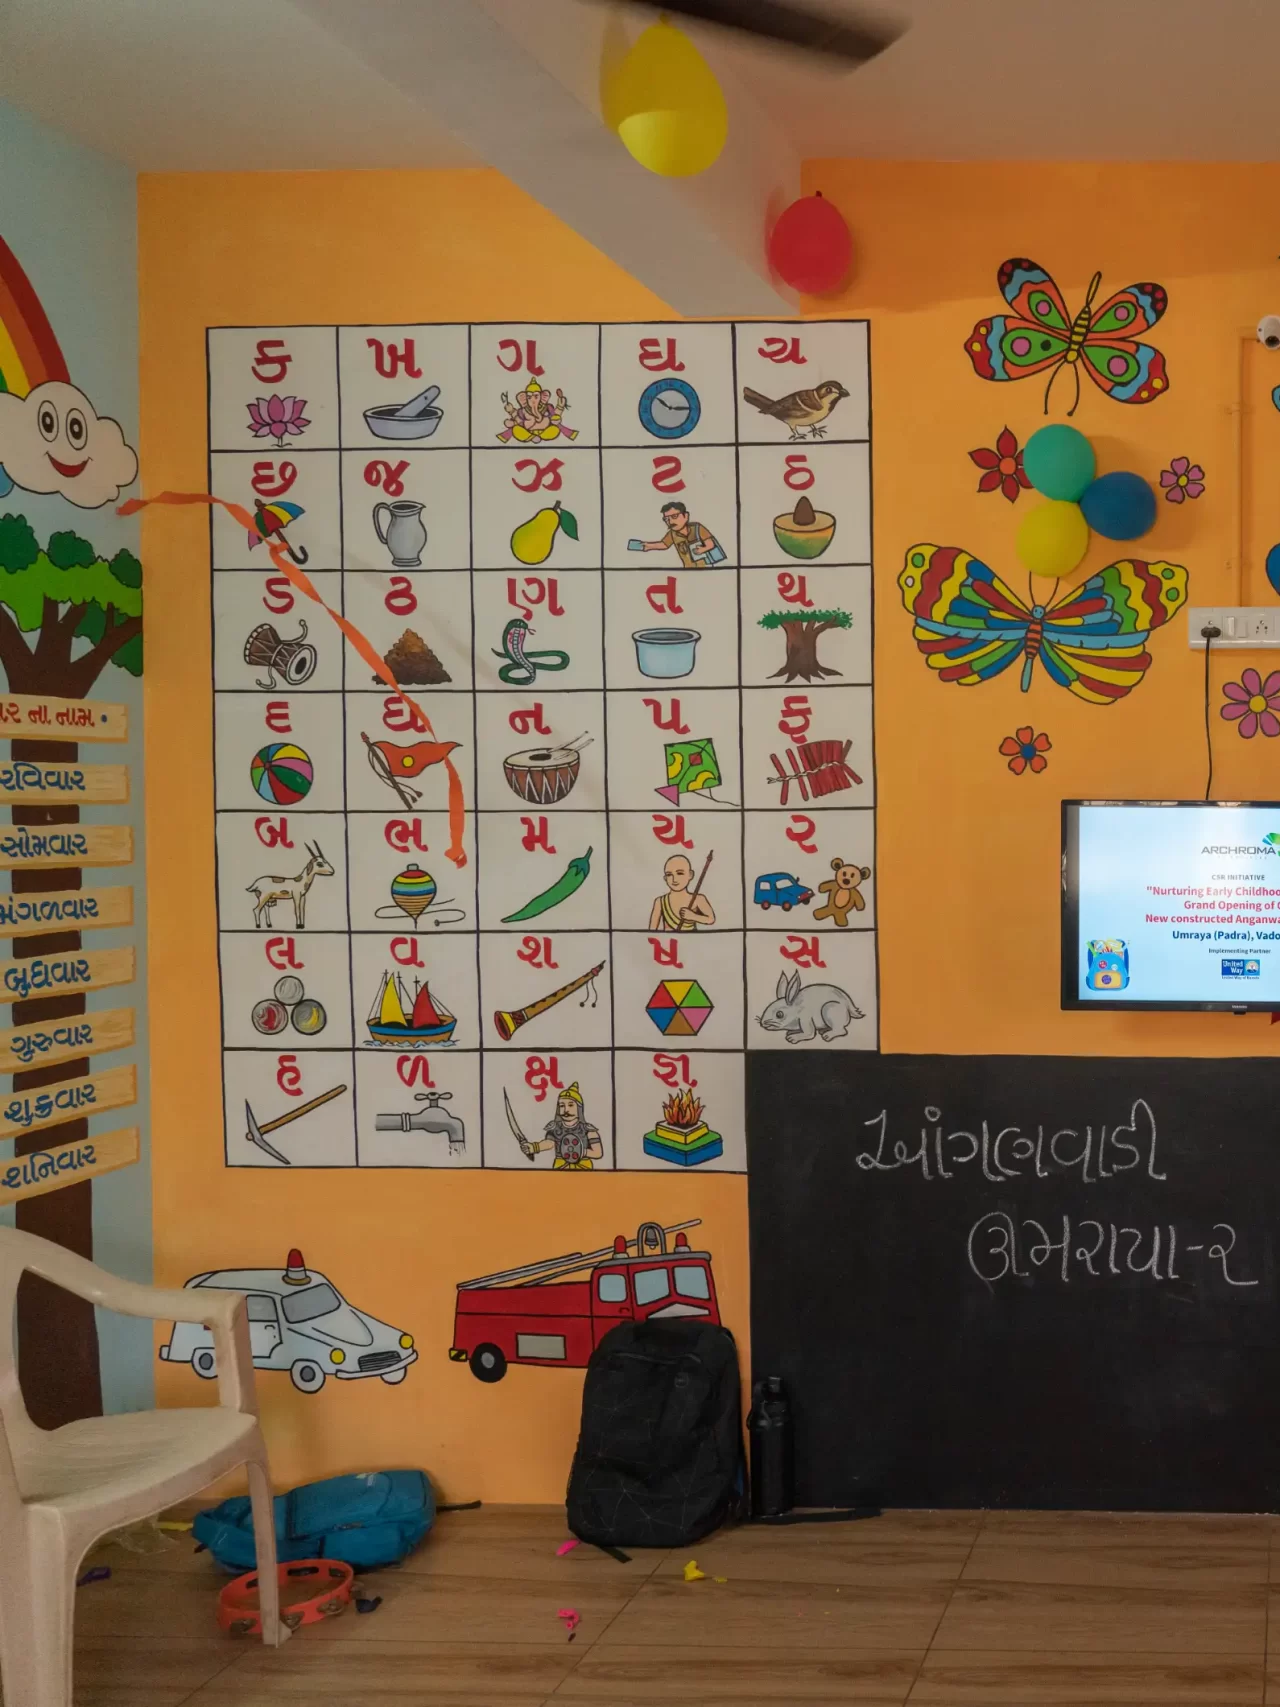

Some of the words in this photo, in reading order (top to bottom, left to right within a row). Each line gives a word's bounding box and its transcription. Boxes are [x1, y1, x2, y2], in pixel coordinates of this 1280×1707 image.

[250, 339, 292, 384] ક
[366, 338, 424, 380] ખ
[498, 339, 545, 376] ગ
[638, 337, 685, 373] ઘ
[757, 336, 808, 366] ચ
[251, 460, 298, 498] છ
[363, 460, 410, 498] જ
[514, 457, 564, 493] ઝ
[651, 455, 686, 494] ટ
[783, 453, 816, 491] ઠ
[262, 576, 296, 615] ડ
[384, 575, 418, 617] ઢ
[506, 576, 565, 621] ણ
[645, 576, 684, 616] ત
[776, 571, 815, 608] થ
[28, 704, 52, 726] ના
[56, 706, 96, 728] નામ
[264, 701, 292, 734] દ
[507, 702, 553, 736] ન
[642, 697, 691, 736] પ
[778, 694, 812, 746] ફ
[0, 762, 86, 791] રવિવાર
[0, 827, 88, 858] સોમવાર
[254, 816, 295, 849] બ
[383, 817, 429, 854] ભ
[519, 815, 557, 856] મ
[651, 813, 695, 850] ય
[784, 813, 819, 855] ર
[1200, 845, 1277, 855] ARCHROMA
[1184, 900, 1216, 910] Grand
[1218, 900, 1262, 913] Opening
[1264, 900, 1275, 910] of
[1206, 886, 1233, 898] Early
[1145, 914, 1168, 924] New
[1170, 913, 1233, 924] constructed
[264, 936, 304, 971] લ
[389, 936, 426, 969] વ
[516, 934, 559, 970] શ
[655, 936, 684, 970] ષ
[778, 934, 827, 970] સ
[1172, 930, 1212, 942] Umraya
[1214, 930, 1254, 942] (Padra),
[1222, 960, 1244, 968] United
[1230, 966, 1244, 975] Way
[10, 1024, 93, 1063] ગુરુવાર
[275, 1054, 304, 1098] હ
[395, 1054, 437, 1089] ળ
[523, 1054, 565, 1103] ક્ષ
[652, 1052, 699, 1089] જ્ઞ
[4, 1083, 96, 1127] શુક્રવાર
[1, 1144, 97, 1189] શનિવાર
